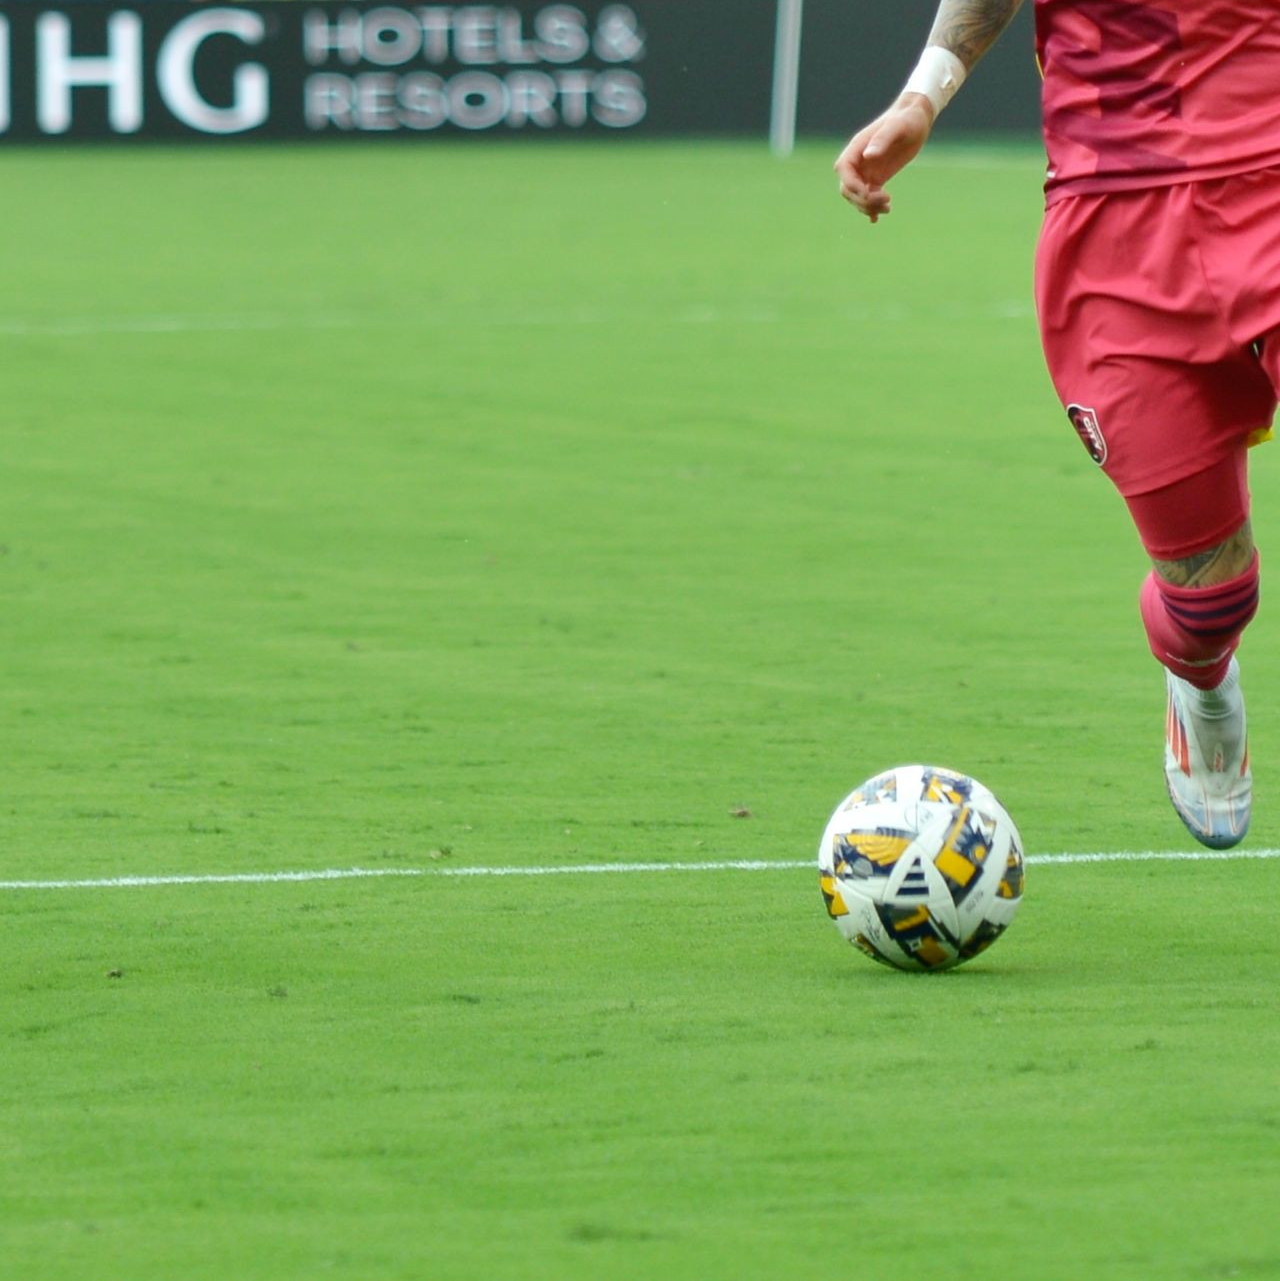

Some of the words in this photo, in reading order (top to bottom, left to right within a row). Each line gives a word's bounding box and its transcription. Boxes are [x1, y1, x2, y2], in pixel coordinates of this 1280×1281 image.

[303, 5, 588, 65] HOTELS
[593, 4, 645, 63] &
[304, 70, 647, 130] RESORTS
